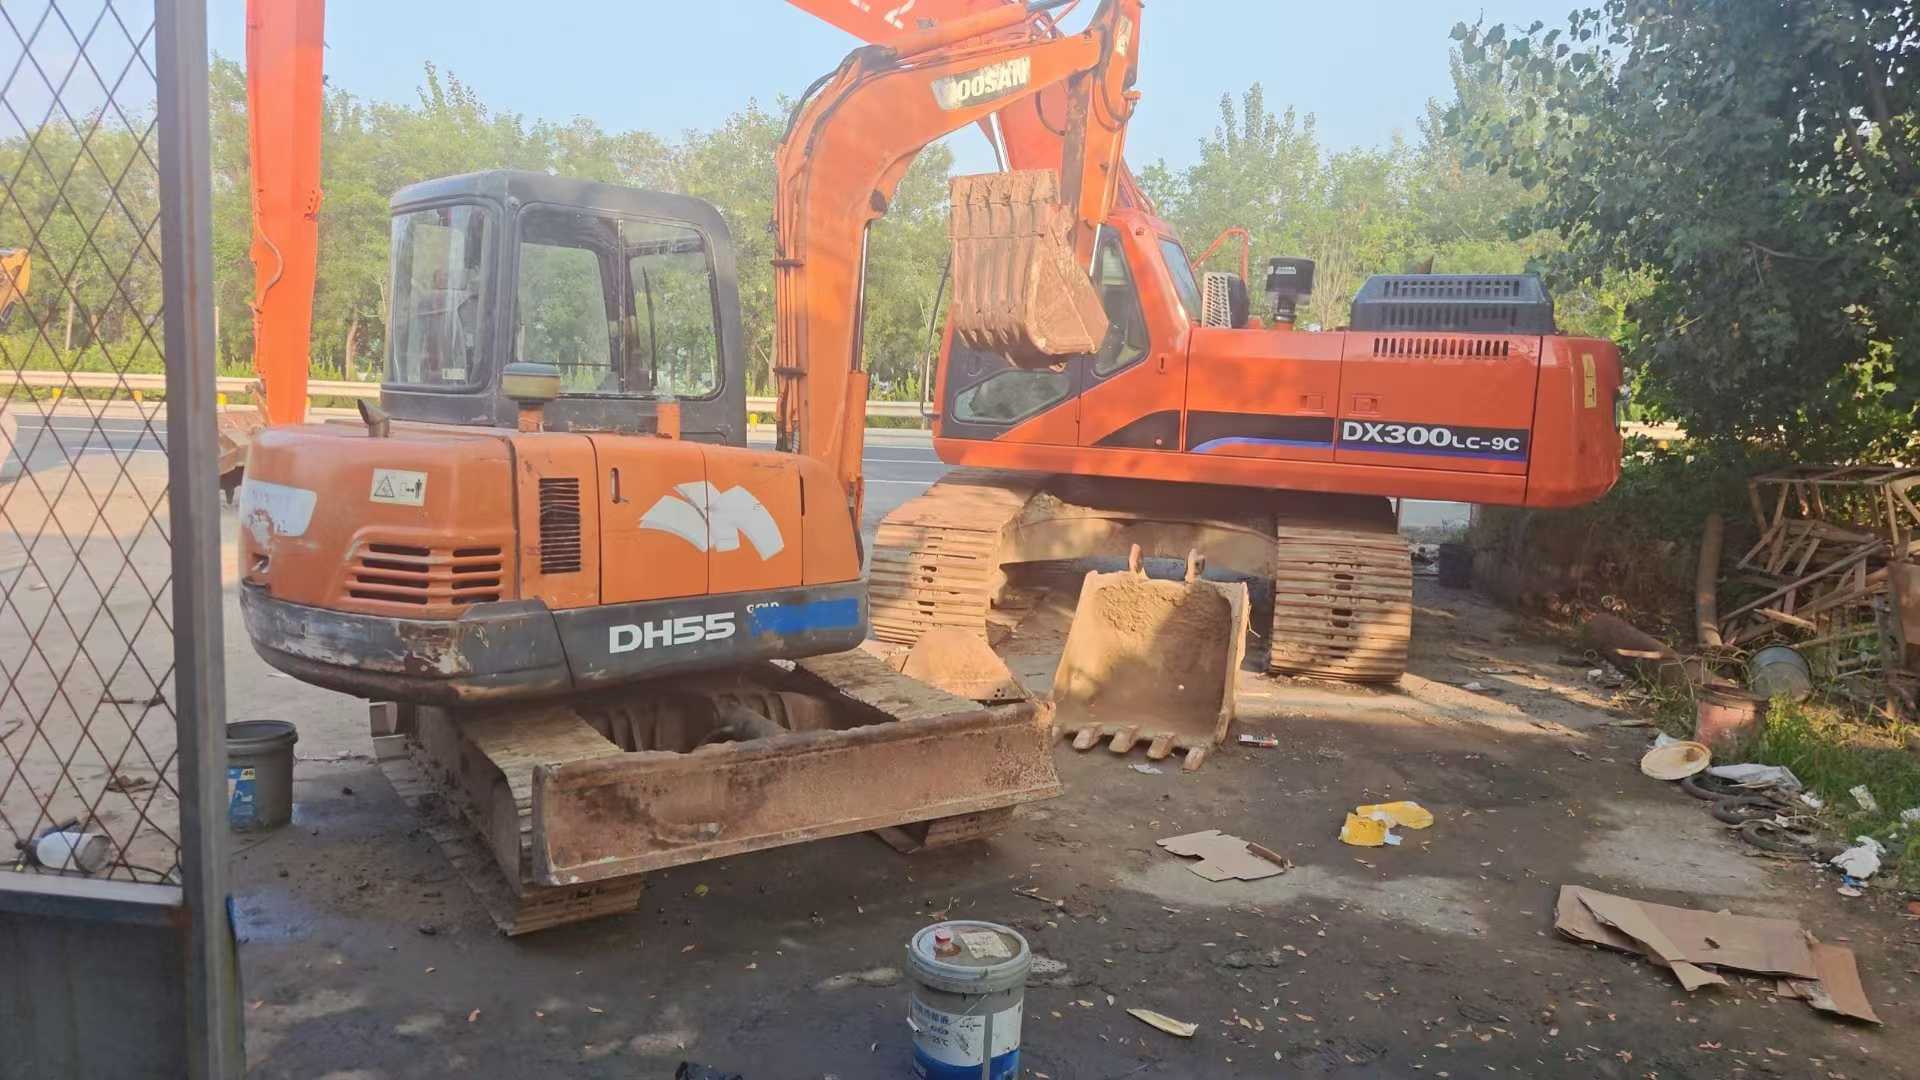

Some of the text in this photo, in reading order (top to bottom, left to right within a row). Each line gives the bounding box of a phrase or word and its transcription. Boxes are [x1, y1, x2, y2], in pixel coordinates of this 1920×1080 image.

[944, 58, 1028, 102] OOSAN
[1342, 421, 1521, 451] DX300LC-9C
[609, 612, 736, 654] DH55
